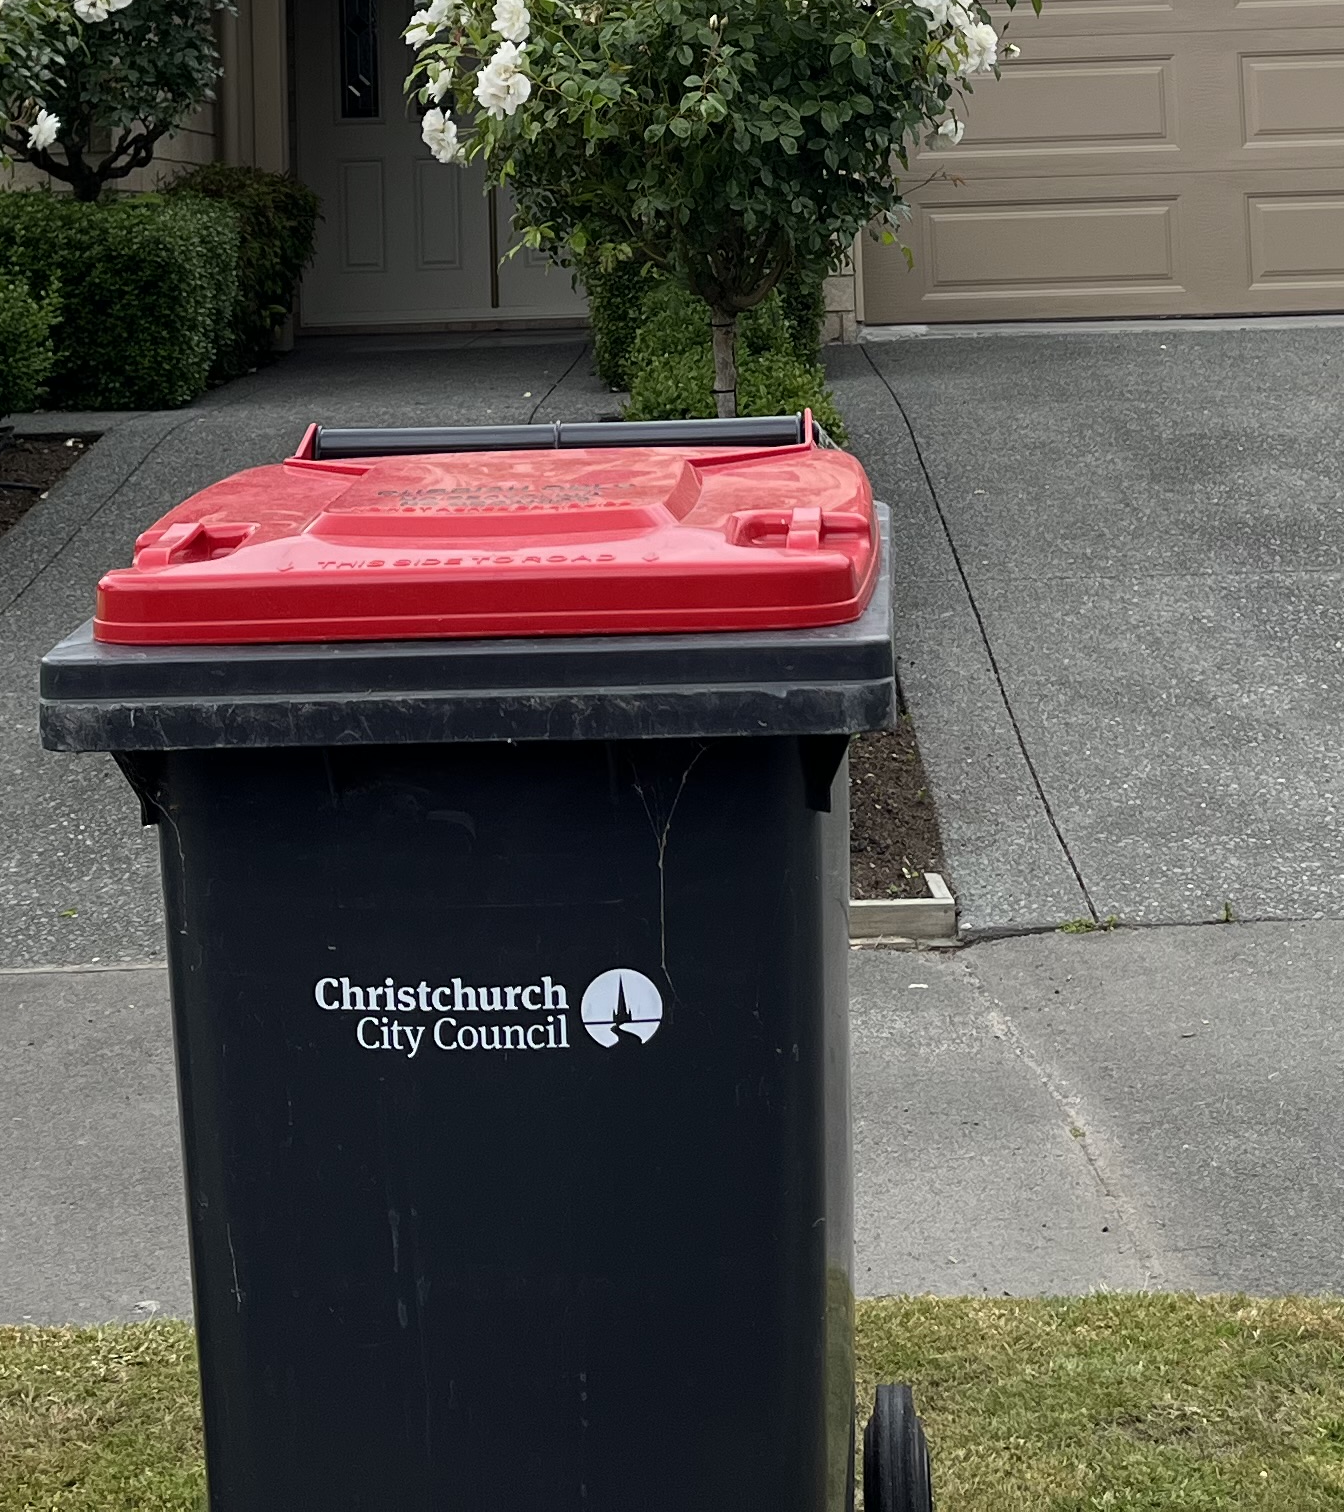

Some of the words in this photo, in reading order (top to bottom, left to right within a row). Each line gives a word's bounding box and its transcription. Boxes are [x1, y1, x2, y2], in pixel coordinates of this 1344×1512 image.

[317, 559, 386, 570] THIS
[392, 557, 463, 567] SIDE
[471, 555, 516, 565] TO
[521, 553, 617, 565] ROAD
[314, 976, 570, 1012] Christchurch
[356, 1015, 426, 1059] City
[433, 1014, 571, 1050] Council
